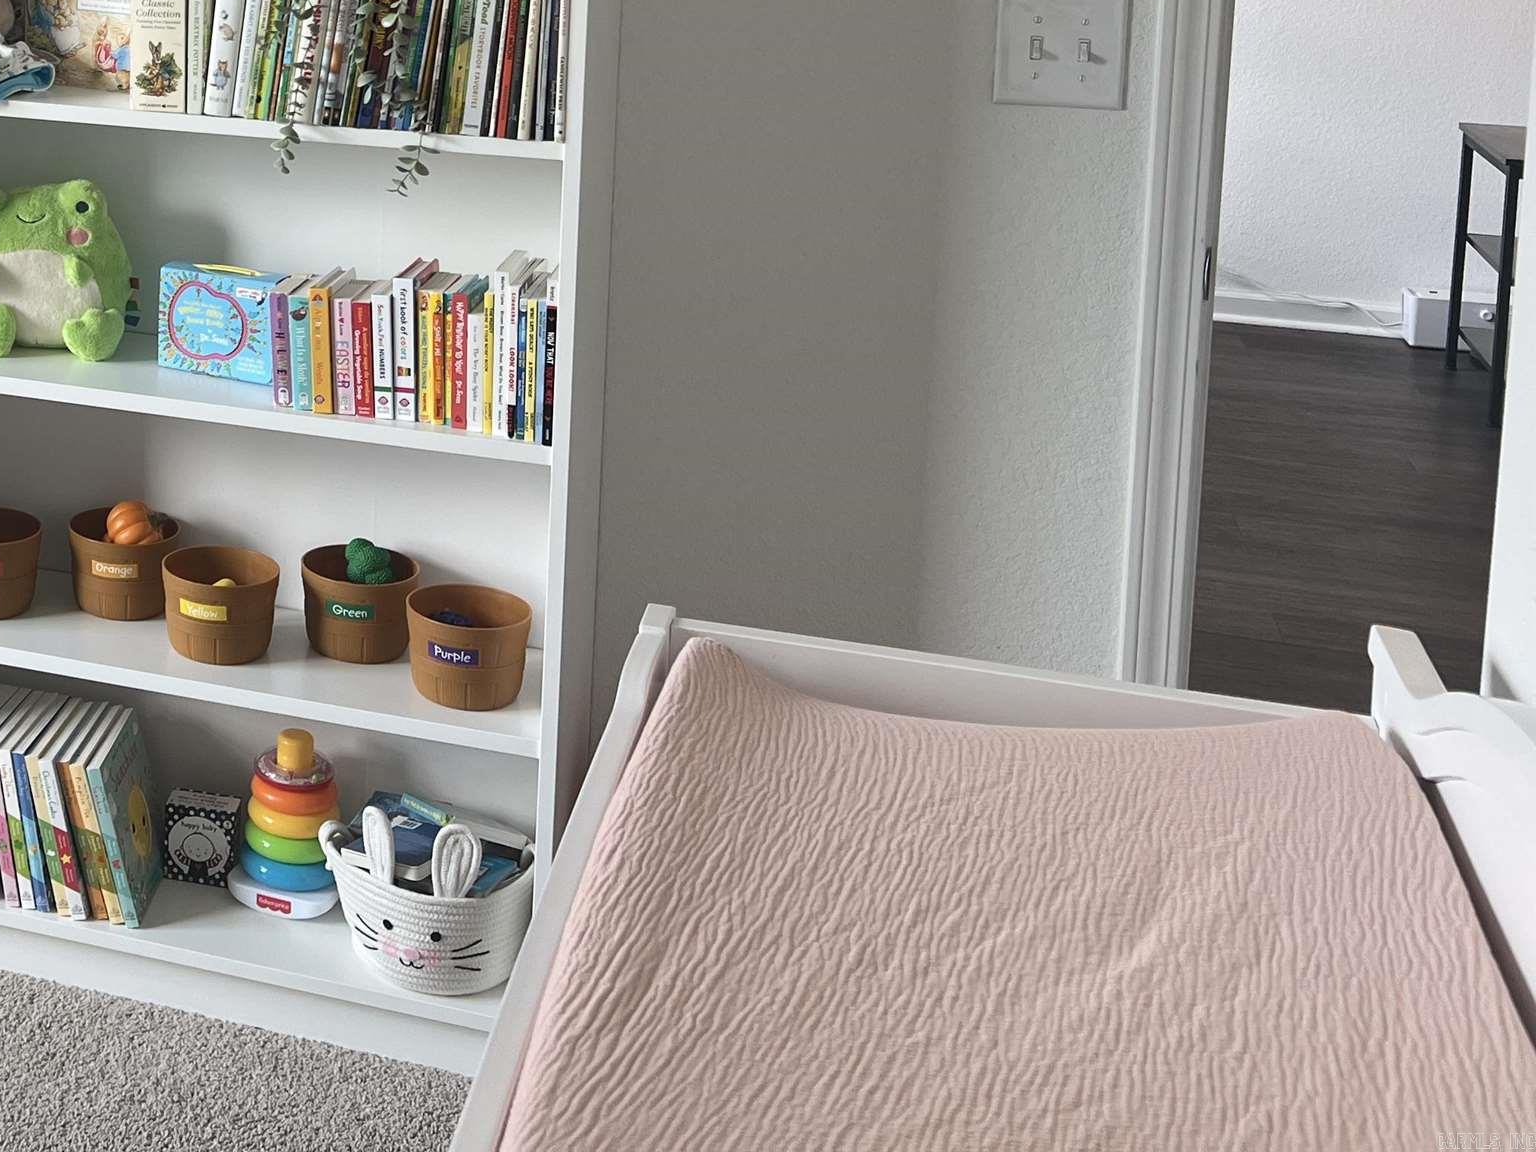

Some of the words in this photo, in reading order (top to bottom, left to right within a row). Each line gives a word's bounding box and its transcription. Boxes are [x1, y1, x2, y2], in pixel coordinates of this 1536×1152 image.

[135, 8, 181, 19] Collection
[193, 1, 201, 15] from
[193, 16, 201, 47] BEATRIX
[192, 48, 200, 76] POTTER
[399, 287, 408, 305] first
[399, 306, 408, 324] book
[295, 326, 305, 347] What
[400, 326, 408, 335] of
[546, 331, 555, 347] NOW
[353, 328, 361, 354] Growing
[399, 336, 408, 360] colors
[336, 340, 351, 389] EASTER
[378, 348, 386, 379] NUMBERS
[508, 347, 516, 367] LOOK
[546, 348, 554, 364] THAT
[297, 362, 307, 386] Sloth?
[354, 355, 362, 384] Vegetable
[508, 369, 516, 392] LOOK!
[94, 563, 134, 578] Orange
[185, 604, 219, 619] Yellow
[332, 604, 368, 621] Green
[433, 643, 472, 665] Purple
